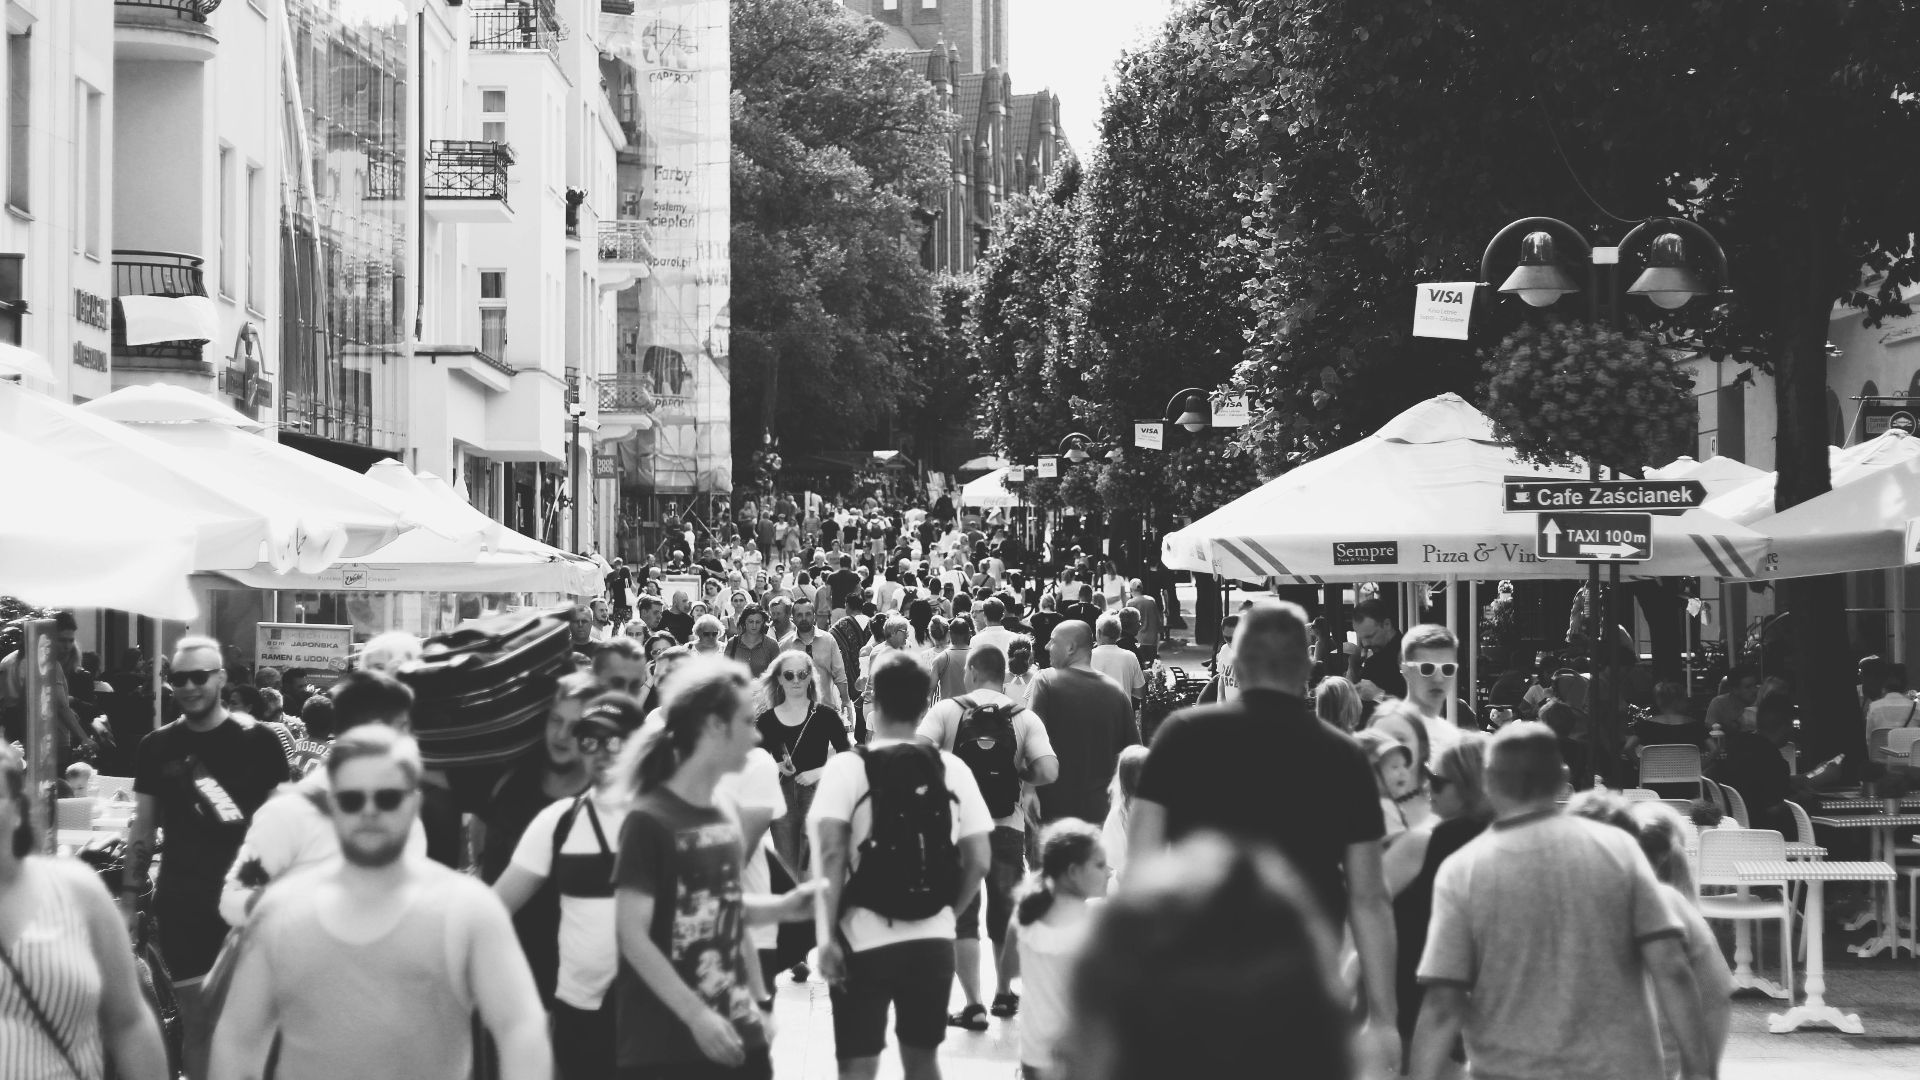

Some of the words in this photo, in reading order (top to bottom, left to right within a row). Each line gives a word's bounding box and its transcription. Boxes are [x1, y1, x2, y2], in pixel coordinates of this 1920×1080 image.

[654, 165, 692, 186] Farby
[653, 201, 687, 214] Systemy
[1428, 288, 1463, 305] VISA
[597, 457, 614, 466] book
[597, 466, 614, 475] book
[1537, 487, 1583, 505] Cafe
[1589, 485, 1694, 505] Zaścianek
[1566, 529, 1600, 543] TAXI
[1605, 530, 1646, 543] 100m
[1336, 543, 1395, 562] Sempre
[1422, 544, 1469, 563] Pizza
[1474, 543, 1497, 562] &
[1501, 543, 1548, 563] Vin
[261, 653, 293, 661] RAMEN
[304, 655, 329, 663] UDON
